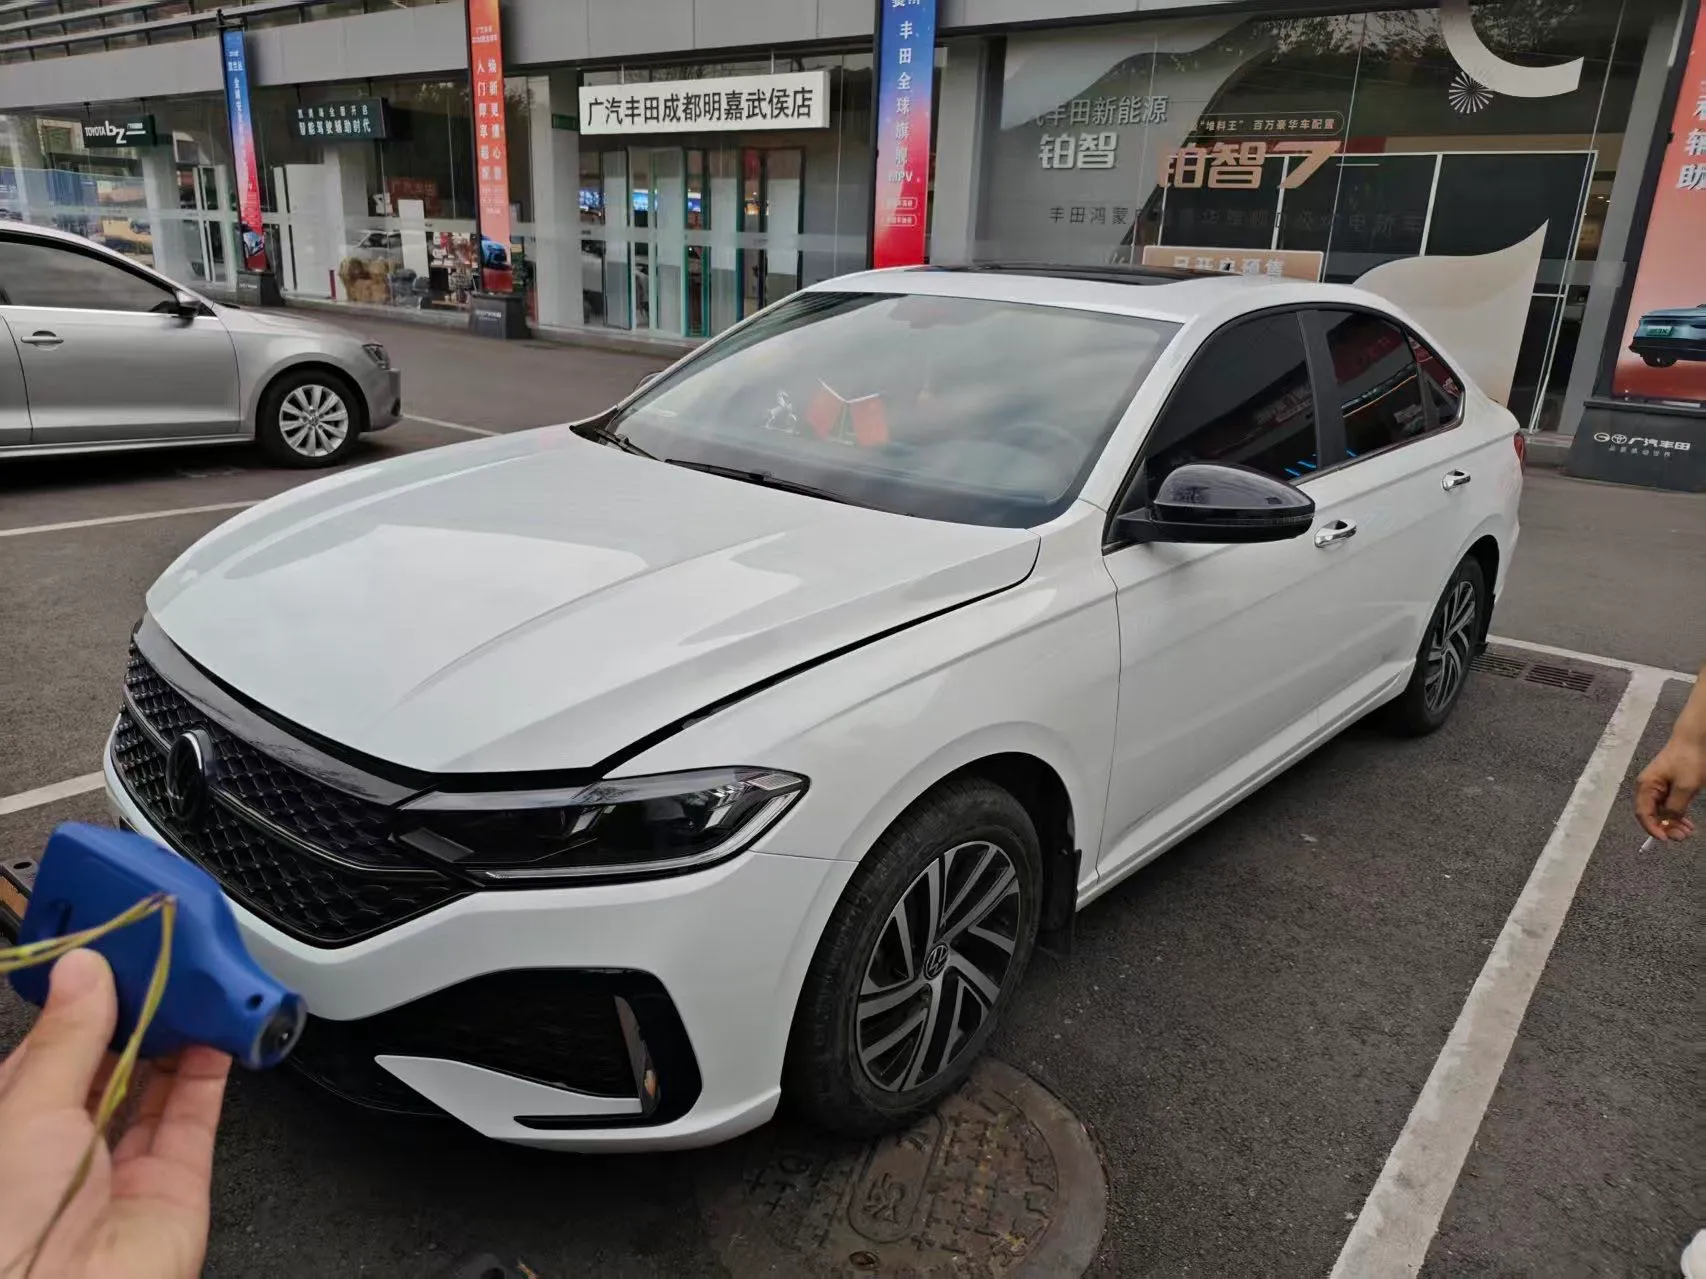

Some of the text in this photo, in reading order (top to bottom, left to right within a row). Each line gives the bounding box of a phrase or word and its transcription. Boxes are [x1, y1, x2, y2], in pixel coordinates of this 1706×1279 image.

[587, 86, 814, 127] 广汽丰田成都明嘉武侯店
[1037, 95, 1169, 126] 丰田新能源
[84, 126, 107, 137] TOYOTA
[1253, 117, 1336, 131] 百万豪华车配置
[1038, 131, 1118, 169] 铂智
[1627, 437, 1692, 451] 广汽丰田
